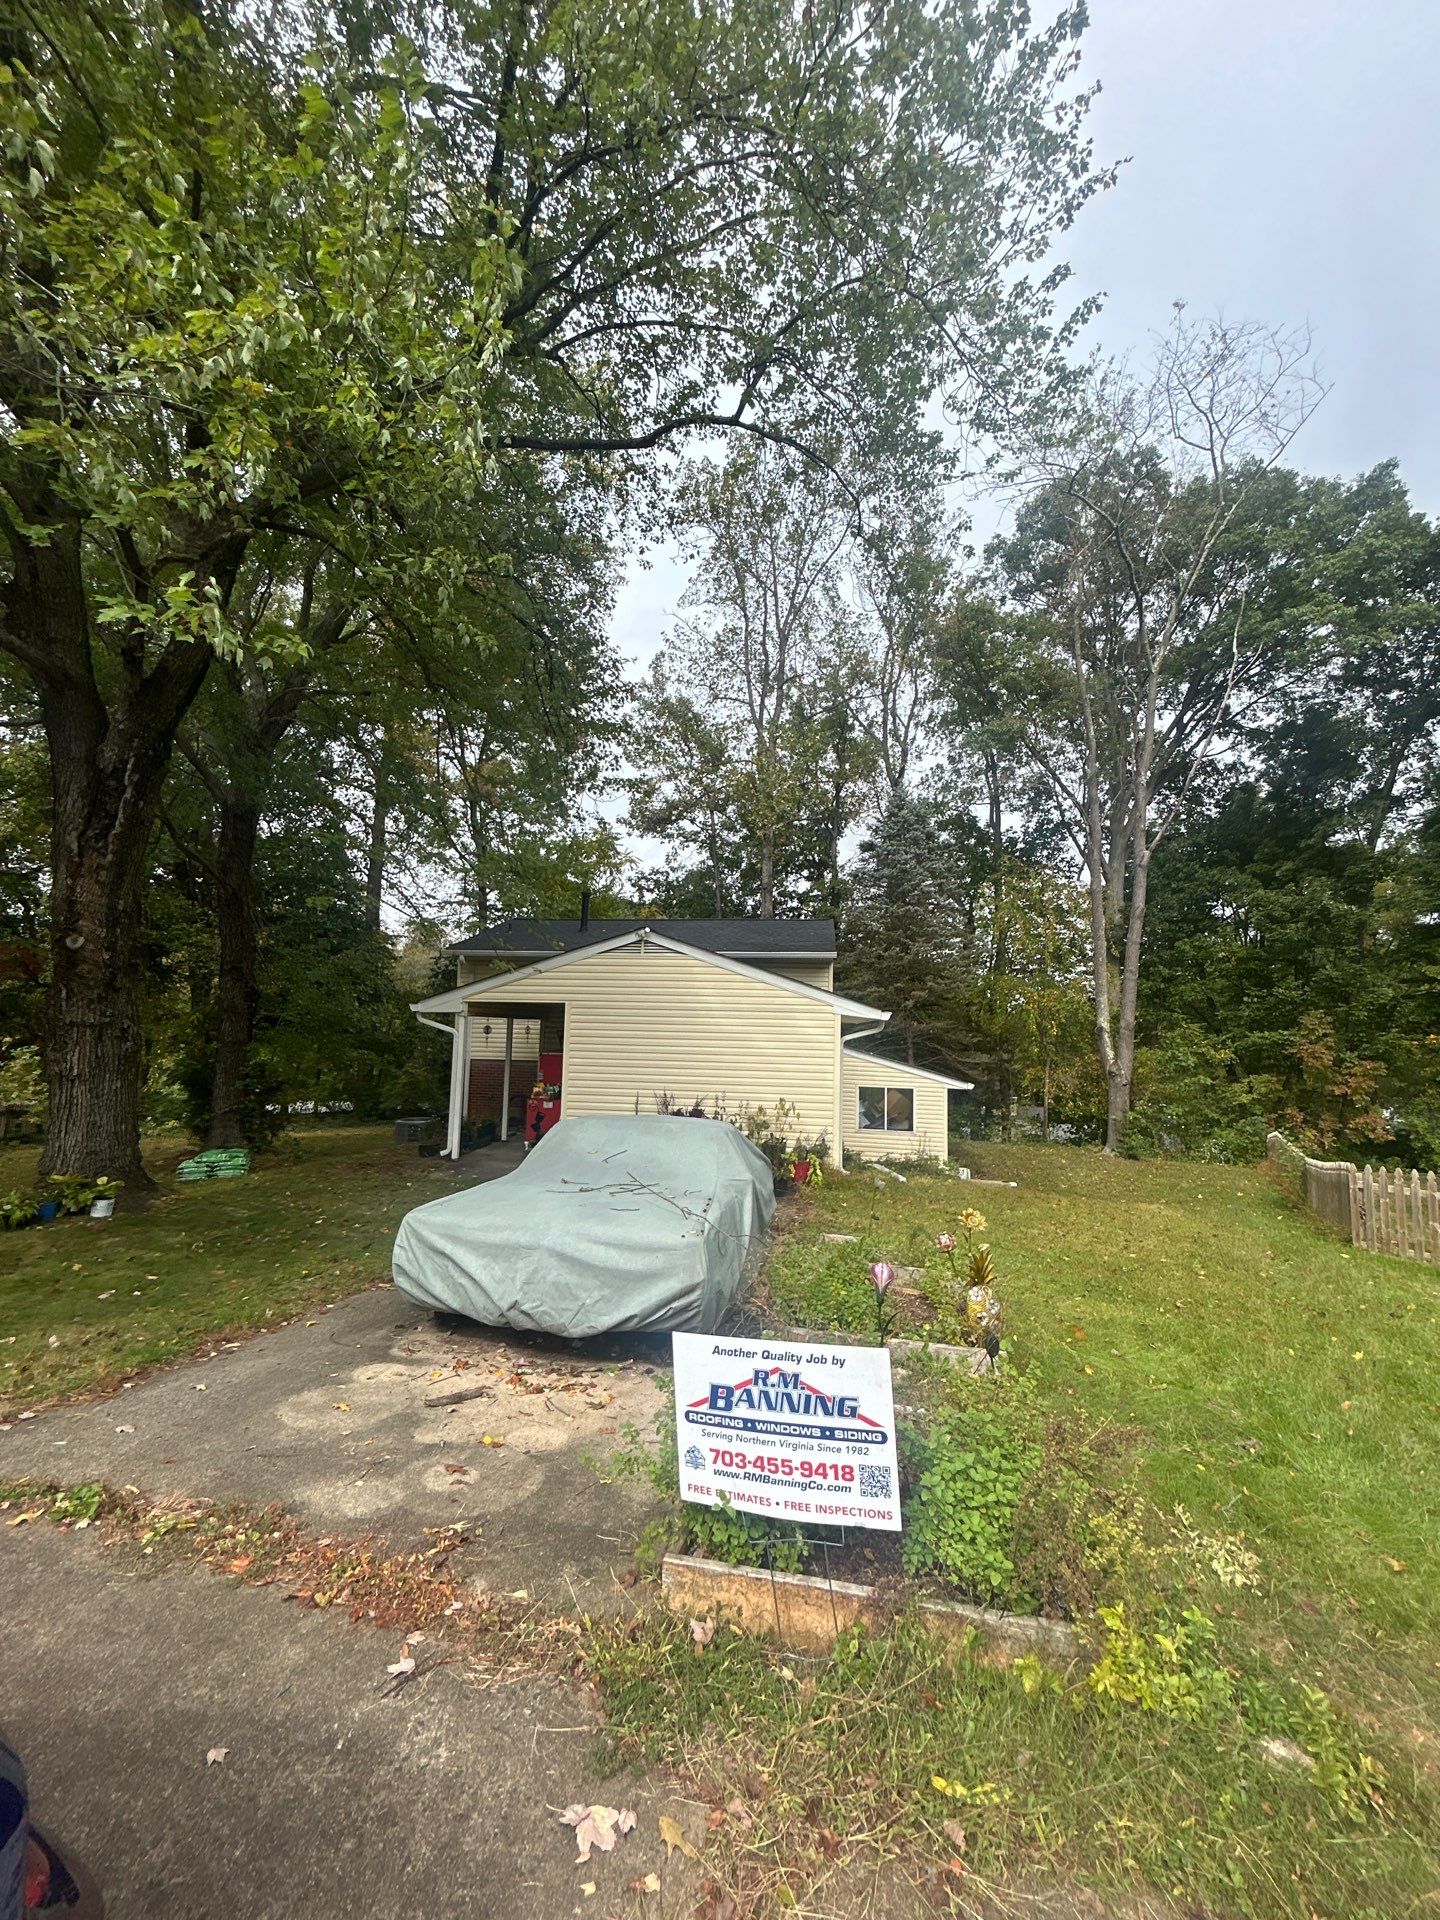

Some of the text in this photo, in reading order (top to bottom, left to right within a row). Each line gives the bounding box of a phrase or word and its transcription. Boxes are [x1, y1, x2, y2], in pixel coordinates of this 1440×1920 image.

[712, 1345, 846, 1368] Another Quality Job by
[752, 1367, 807, 1391] R.M.
[707, 1382, 860, 1420] BANNING
[688, 1412, 883, 1442] ROOFING WINDOWS SIDING
[701, 1428, 870, 1456] Serving Northern Virginia Since 1982
[709, 1448, 855, 1482] 703-455-9418
[713, 1468, 852, 1493] www.RMBanningCo.com
[687, 1483, 893, 1521] FREE ETIMATES FREE INSPECTIONS
